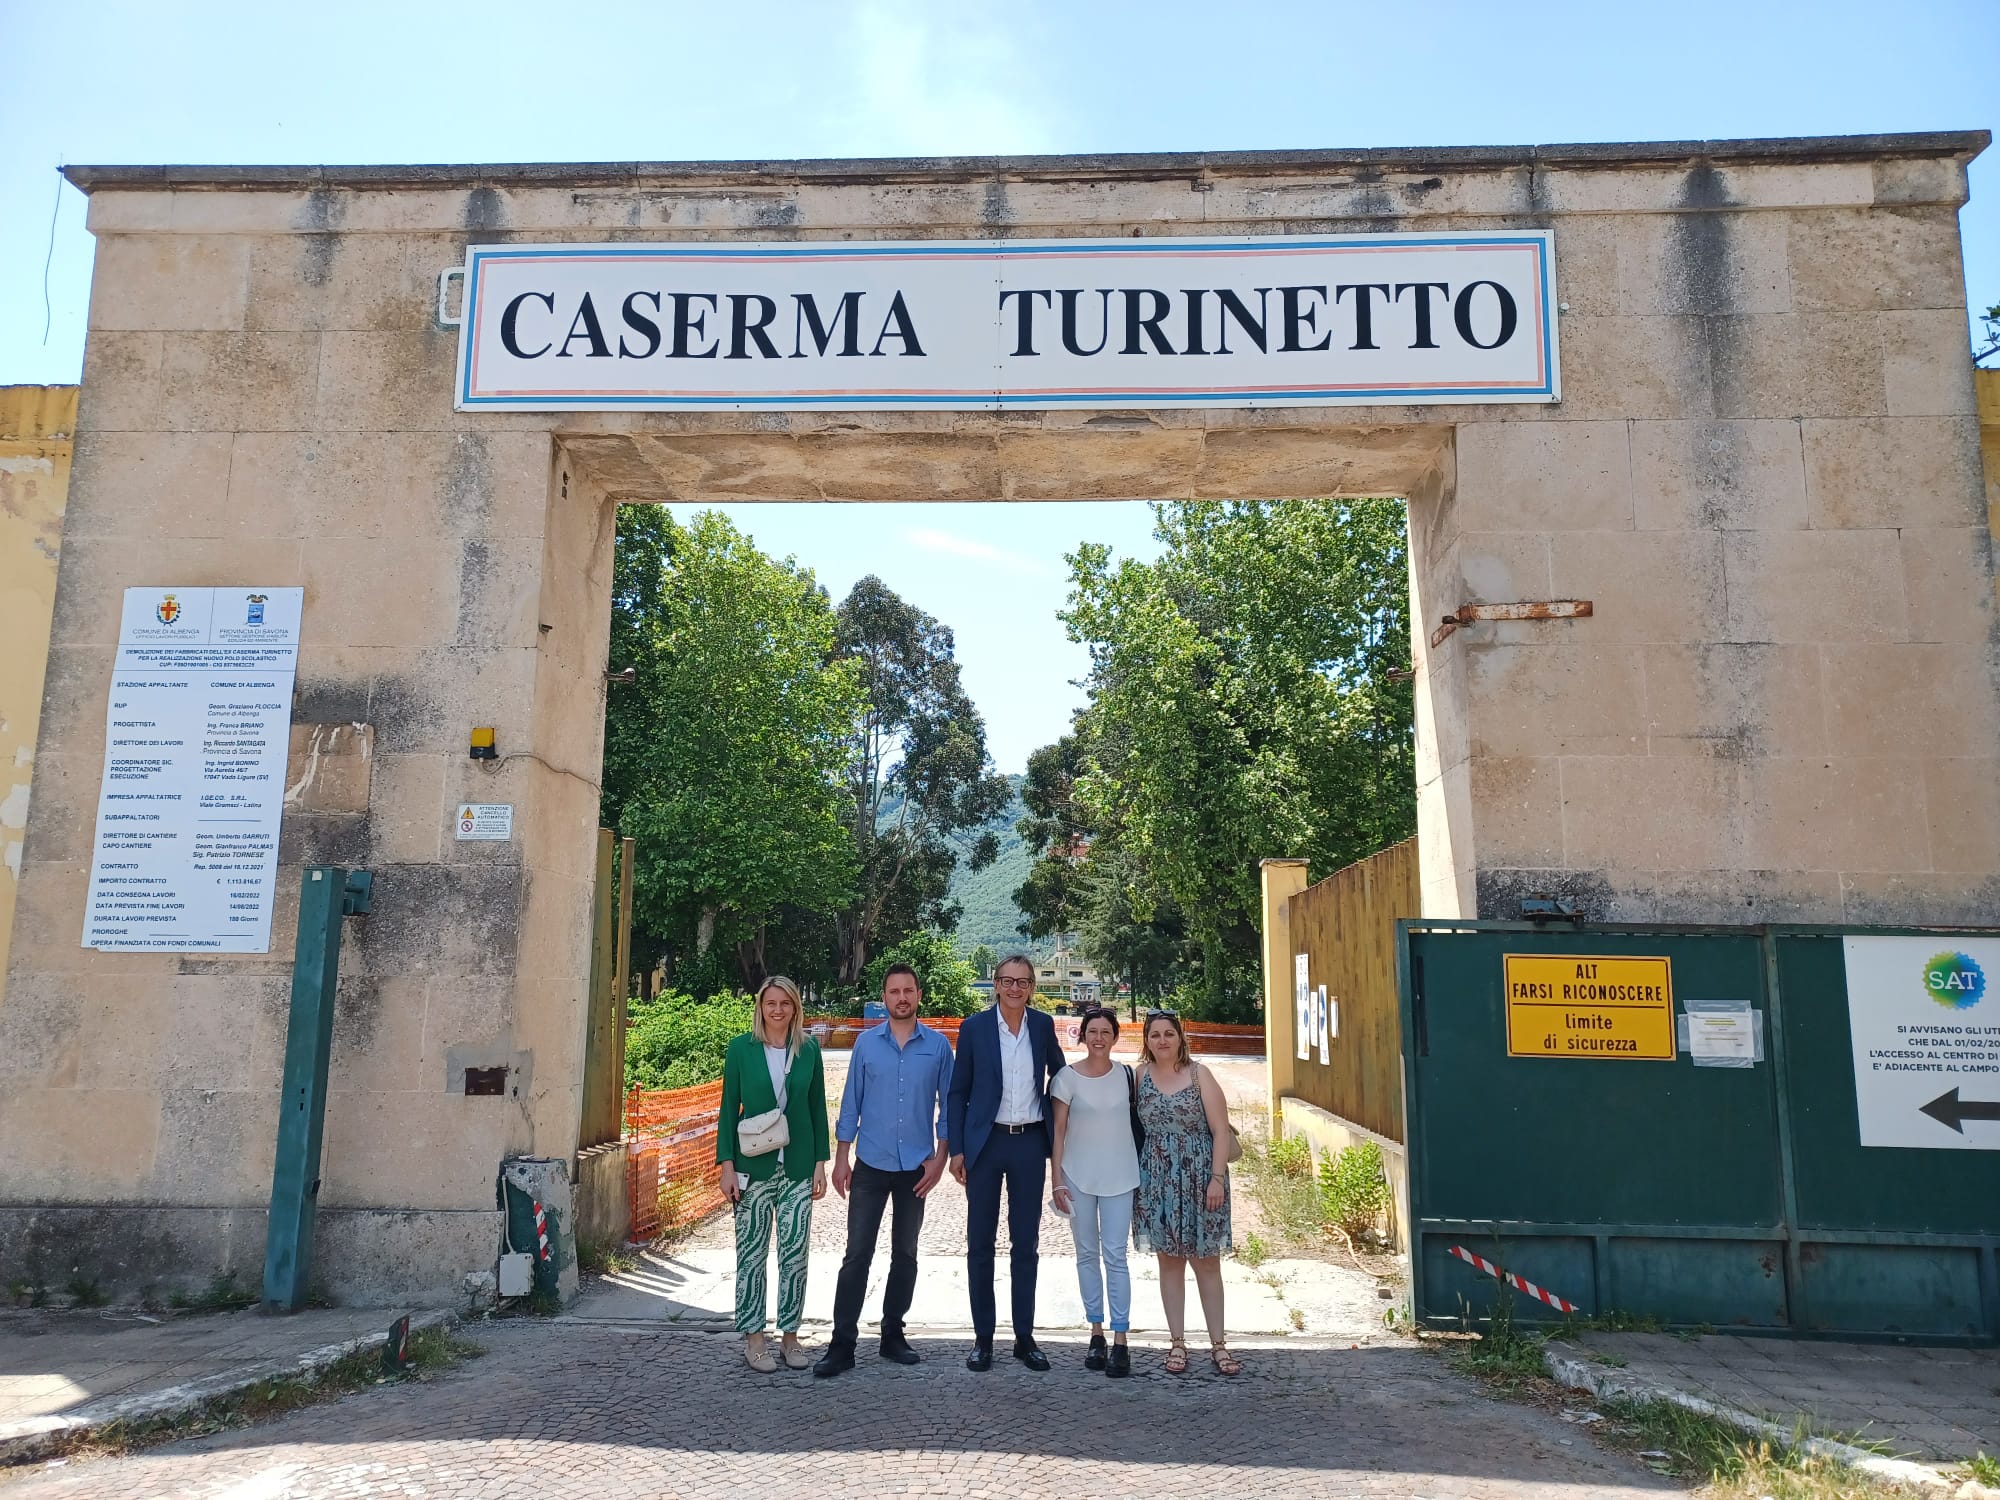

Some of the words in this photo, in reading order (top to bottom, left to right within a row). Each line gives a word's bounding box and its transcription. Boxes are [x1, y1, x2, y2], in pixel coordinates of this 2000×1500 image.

[500, 290, 927, 360] CASERMA
[999, 280, 1518, 357] TURINETTO
[1576, 964, 1597, 979] ALT
[1928, 971, 1977, 990] SAT
[1513, 984, 1552, 998] FARSI
[1564, 985, 1663, 1001] RICONOSCERE
[1566, 1014, 1613, 1030] limite
[1544, 1034, 1557, 1049] di
[1568, 1035, 1637, 1051] sicurezza
[1870, 1051, 1924, 1059] L'ACCESSO
[1884, 1063, 1943, 1071] ADIACENTE
